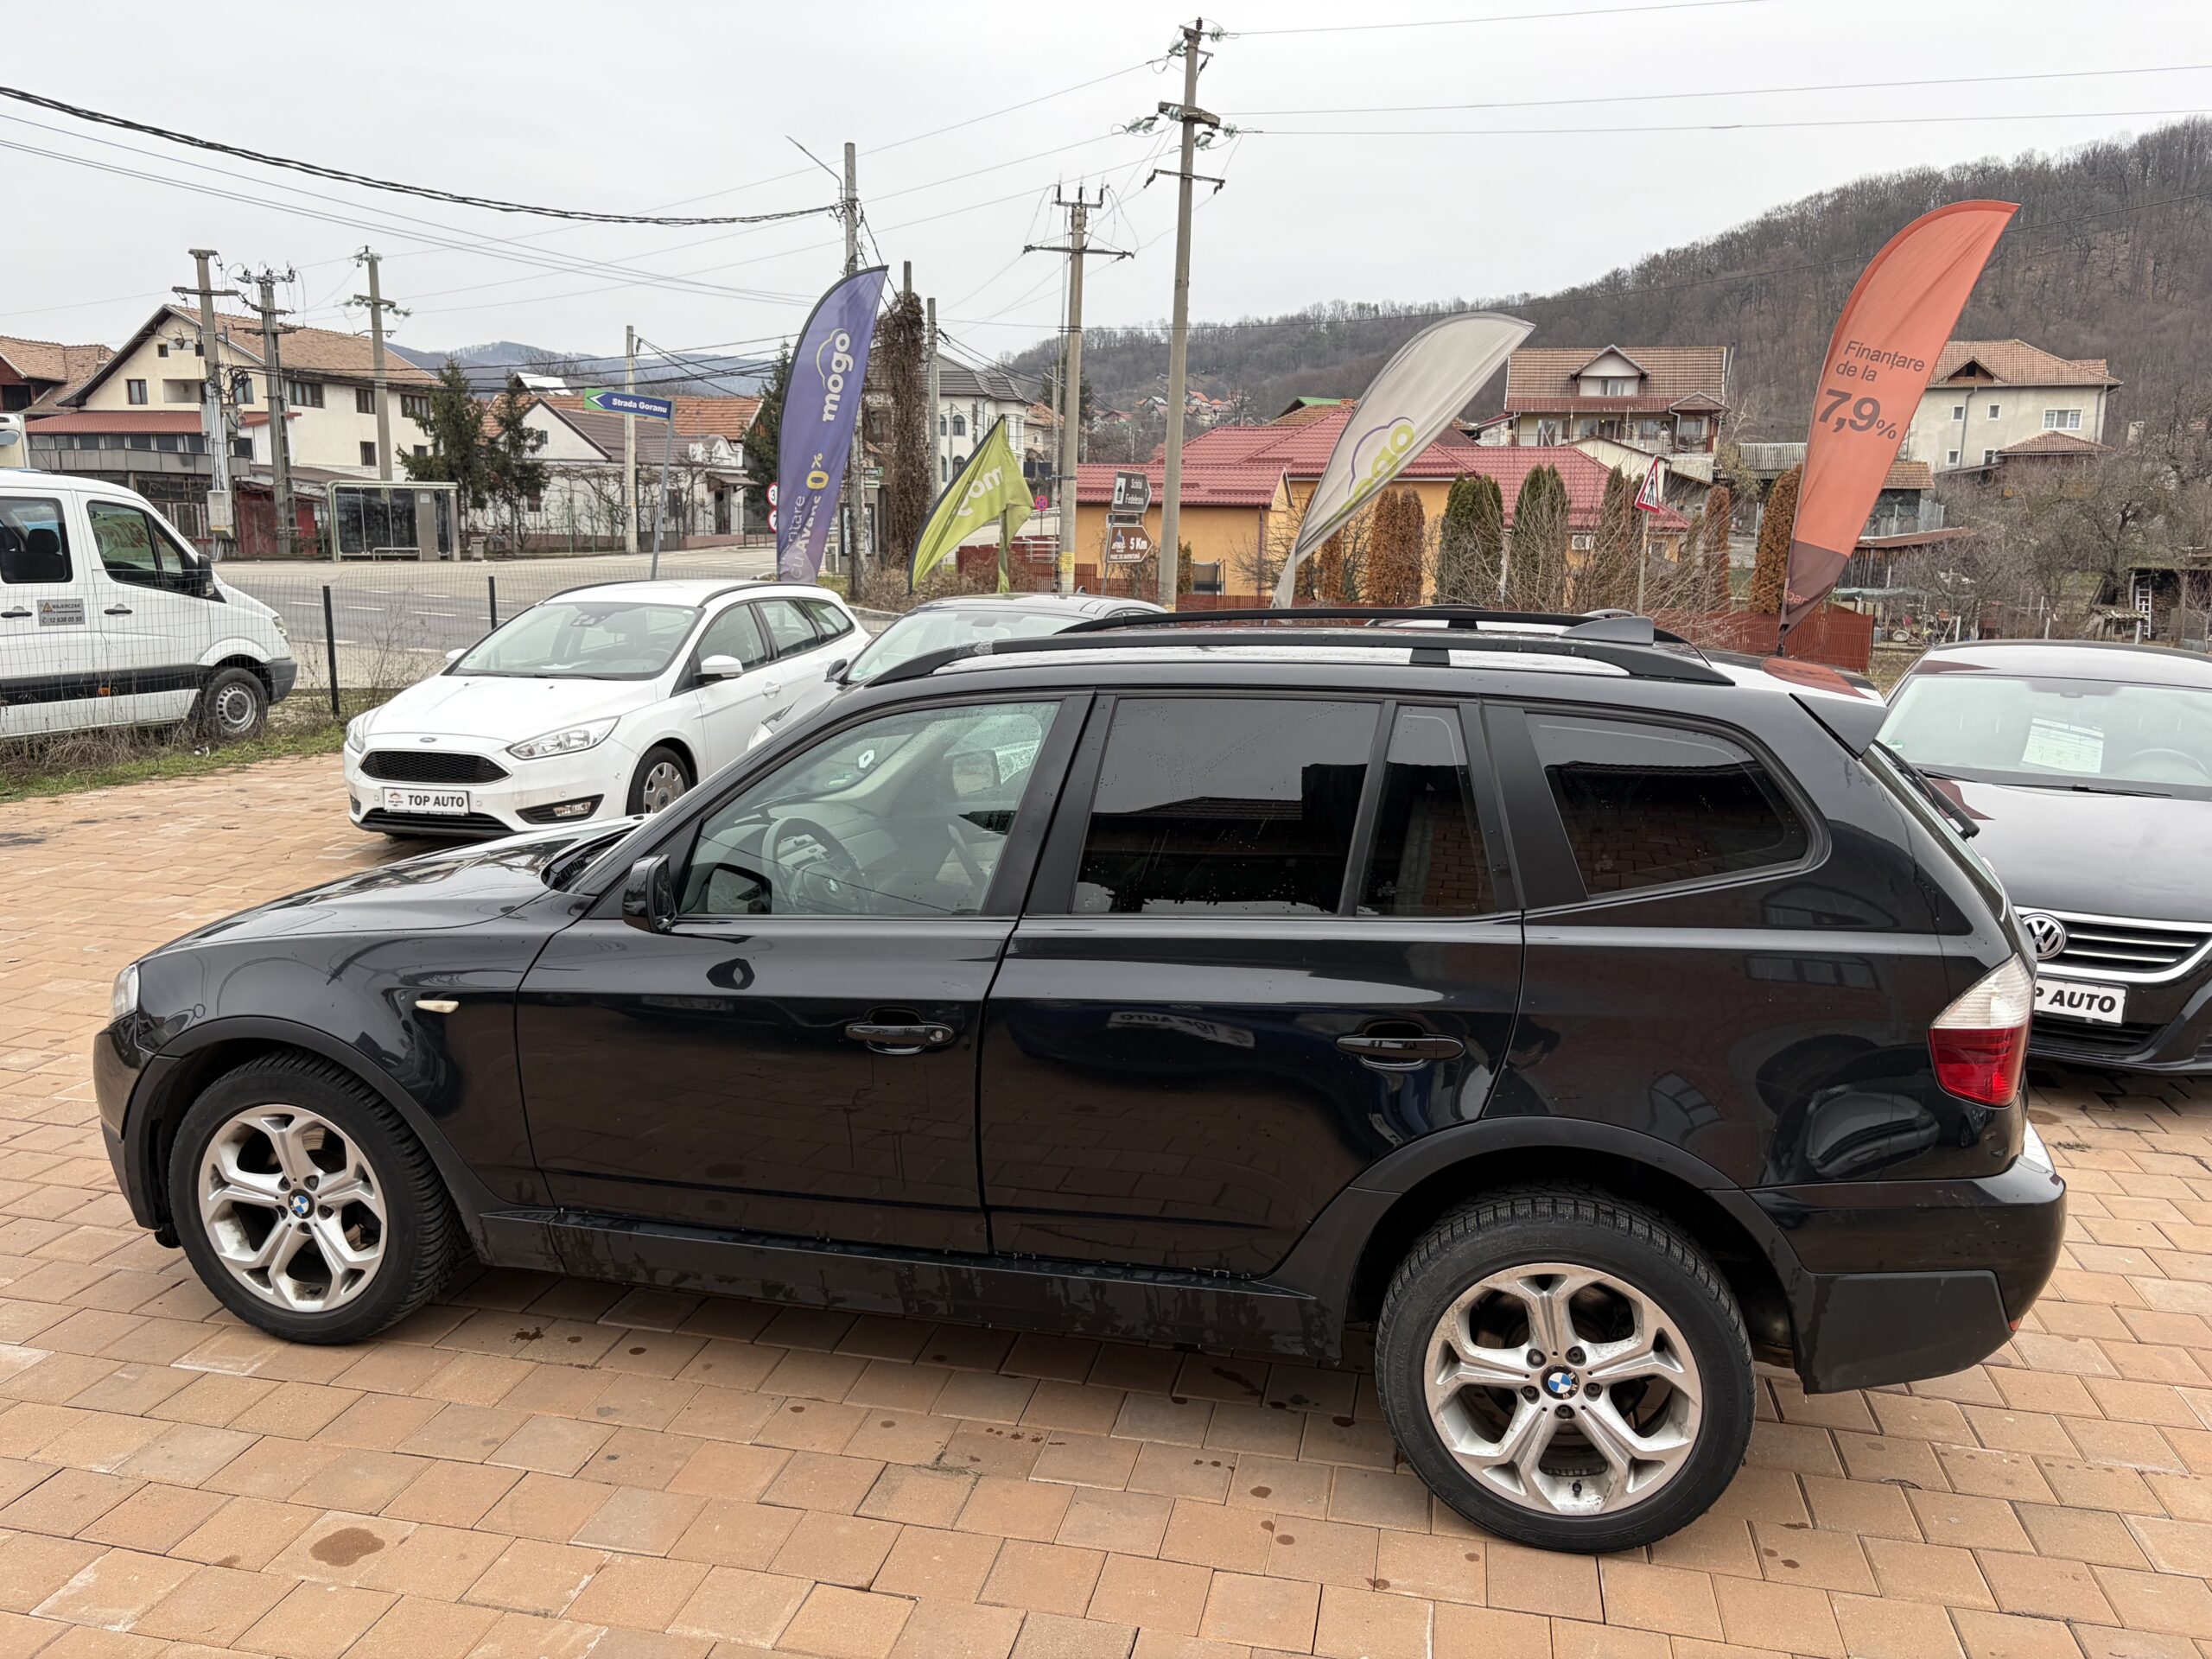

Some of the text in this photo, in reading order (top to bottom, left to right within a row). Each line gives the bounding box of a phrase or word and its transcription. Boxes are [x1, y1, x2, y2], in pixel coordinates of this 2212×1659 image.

[1844, 340, 1925, 372] Finanțare
[822, 333, 855, 423] mogo
[1835, 360, 1878, 382] de la
[612, 397, 668, 414] Strada Goranu
[1818, 388, 1897, 440] 7,9%
[1129, 537, 1135, 550] 5
[1135, 537, 1147, 550] Km
[408, 794, 430, 806] TOP
[433, 795, 465, 807] AUTO
[2048, 989, 2116, 1014] AUTO
